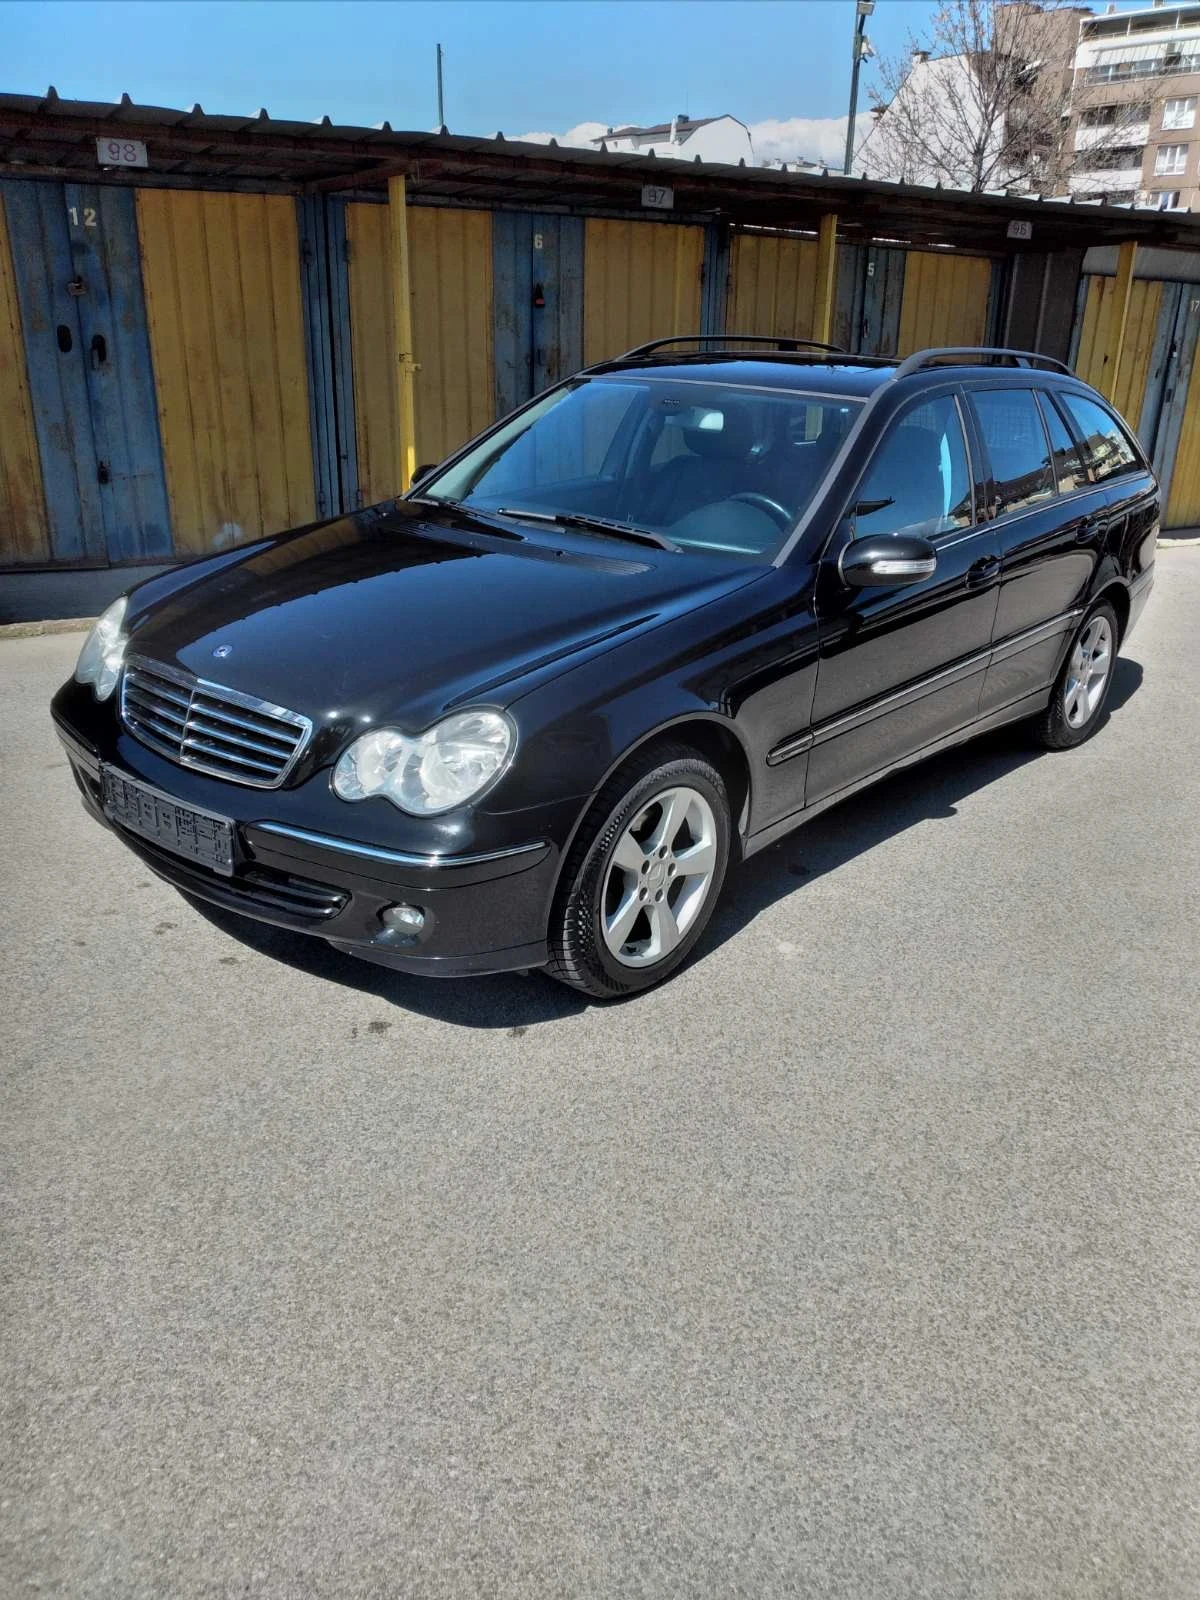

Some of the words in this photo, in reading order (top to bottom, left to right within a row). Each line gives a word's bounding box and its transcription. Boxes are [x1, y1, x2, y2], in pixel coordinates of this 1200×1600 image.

[107, 142, 137, 162] 98
[648, 189, 666, 205] 97
[68, 207, 97, 226] 12
[534, 234, 543, 249] 6
[867, 262, 874, 276] 5
